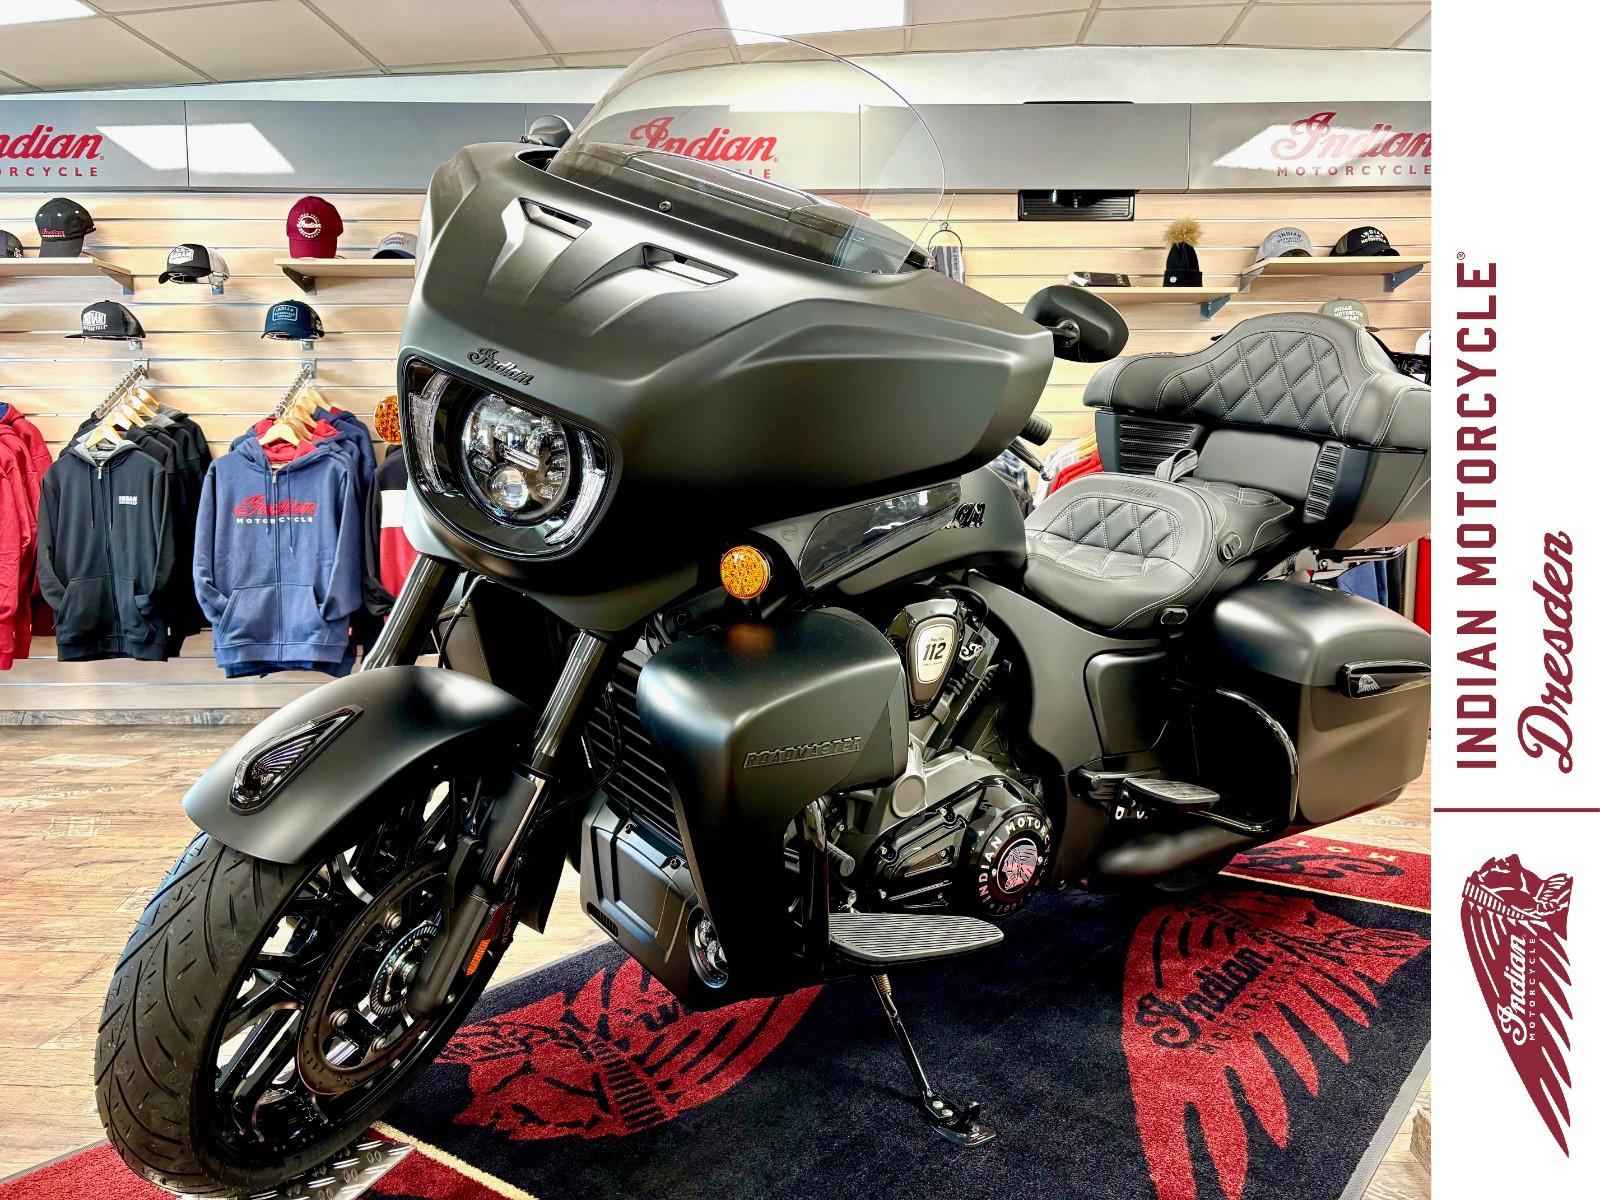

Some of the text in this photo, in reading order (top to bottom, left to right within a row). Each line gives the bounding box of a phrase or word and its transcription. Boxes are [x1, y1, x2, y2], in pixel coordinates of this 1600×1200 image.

[630, 117, 777, 161] Indian
[1271, 111, 1431, 160] Indian
[1277, 165, 1431, 177] MOTORCYCLE
[467, 347, 535, 386] Indian
[923, 642, 947, 661] 112
[743, 736, 862, 768] ROADMASTER
[1134, 947, 1274, 1048] Indian
